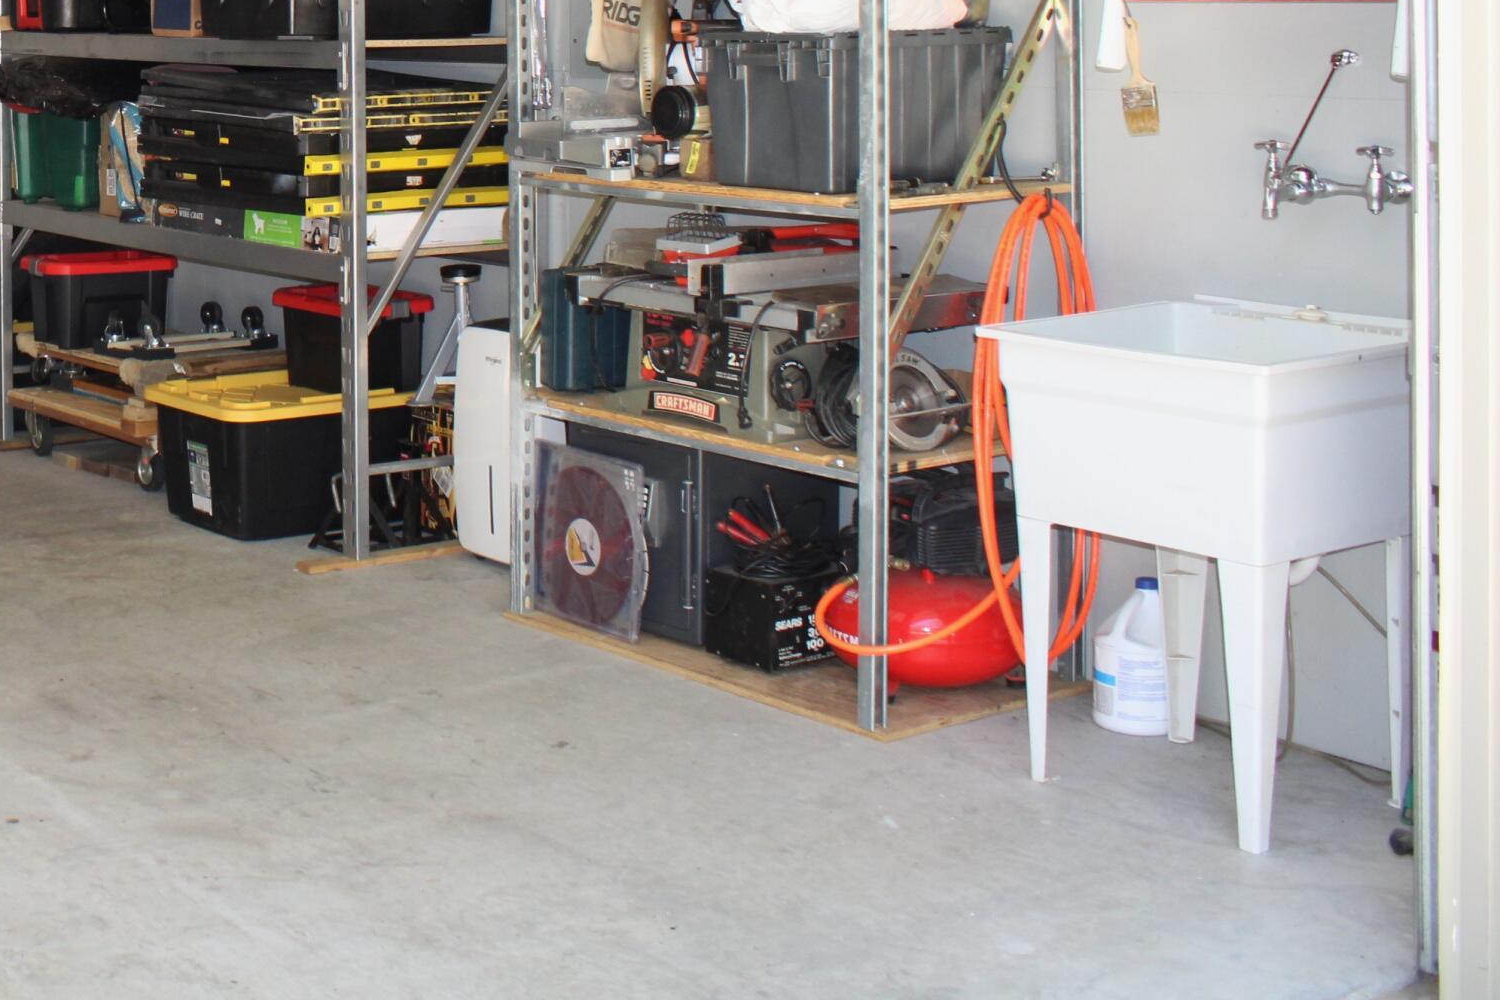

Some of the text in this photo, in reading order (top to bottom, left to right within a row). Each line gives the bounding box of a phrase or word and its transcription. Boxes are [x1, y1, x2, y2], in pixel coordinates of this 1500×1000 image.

[656, 395, 711, 417] CRAFTSMAN
[774, 616, 803, 632] SEARS
[806, 637, 824, 651] 100
